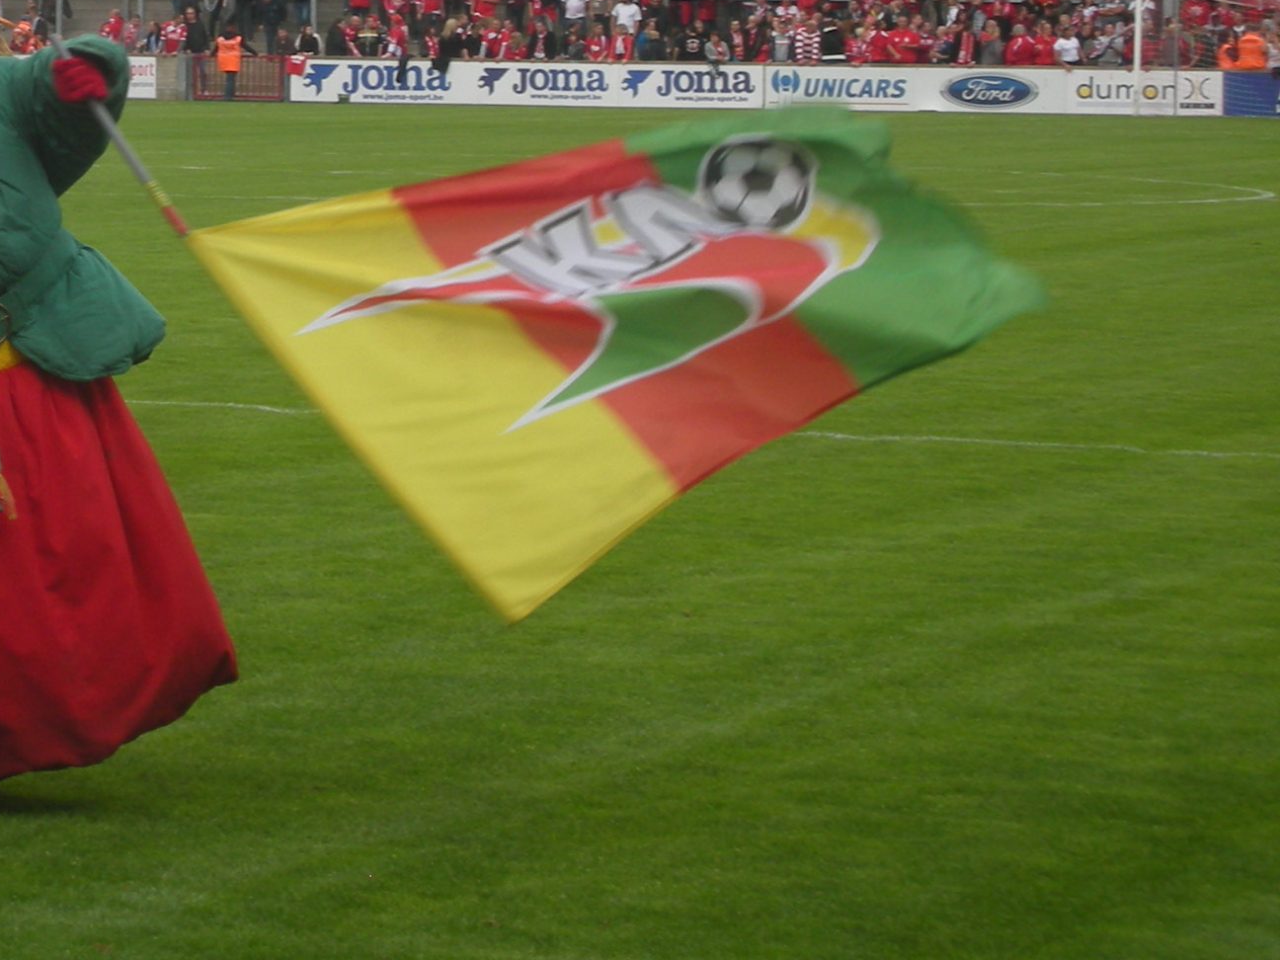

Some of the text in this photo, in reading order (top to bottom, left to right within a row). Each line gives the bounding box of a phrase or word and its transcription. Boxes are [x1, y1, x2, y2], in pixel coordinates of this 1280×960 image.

[512, 68, 609, 94] Joma
[804, 78, 908, 98] UNICARS
[961, 79, 1016, 101] Ford
